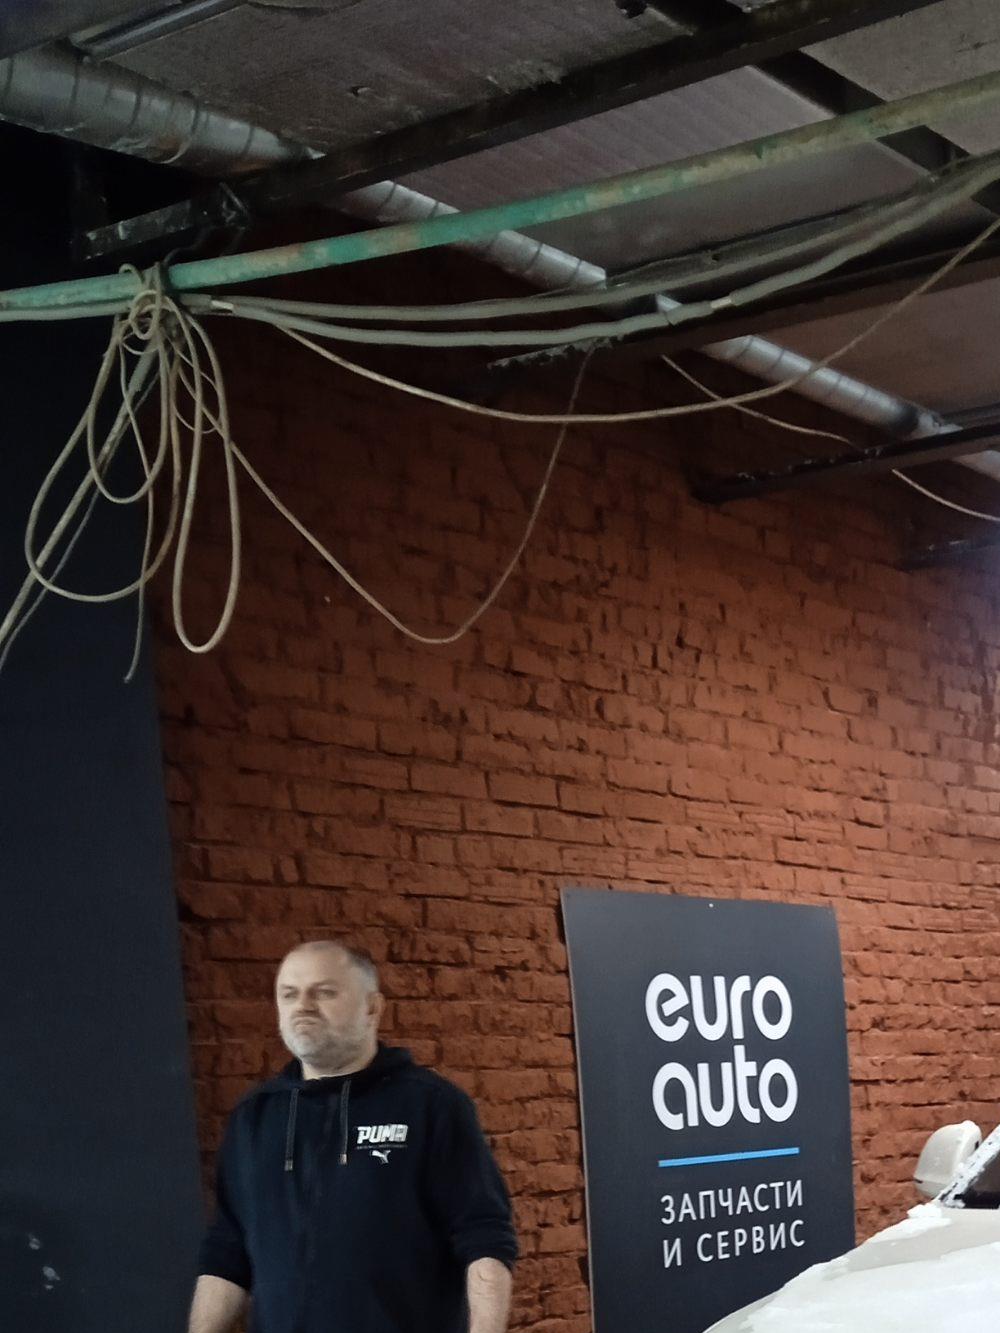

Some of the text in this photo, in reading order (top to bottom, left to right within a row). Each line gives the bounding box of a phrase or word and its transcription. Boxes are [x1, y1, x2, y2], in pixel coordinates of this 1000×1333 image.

[646, 973, 792, 1042] euro
[652, 1045, 798, 1131] auto
[357, 1124, 408, 1144] PUMA
[660, 1179, 804, 1226] ЗАПЧАСТИ
[663, 1219, 806, 1268] И СЕРВИС
